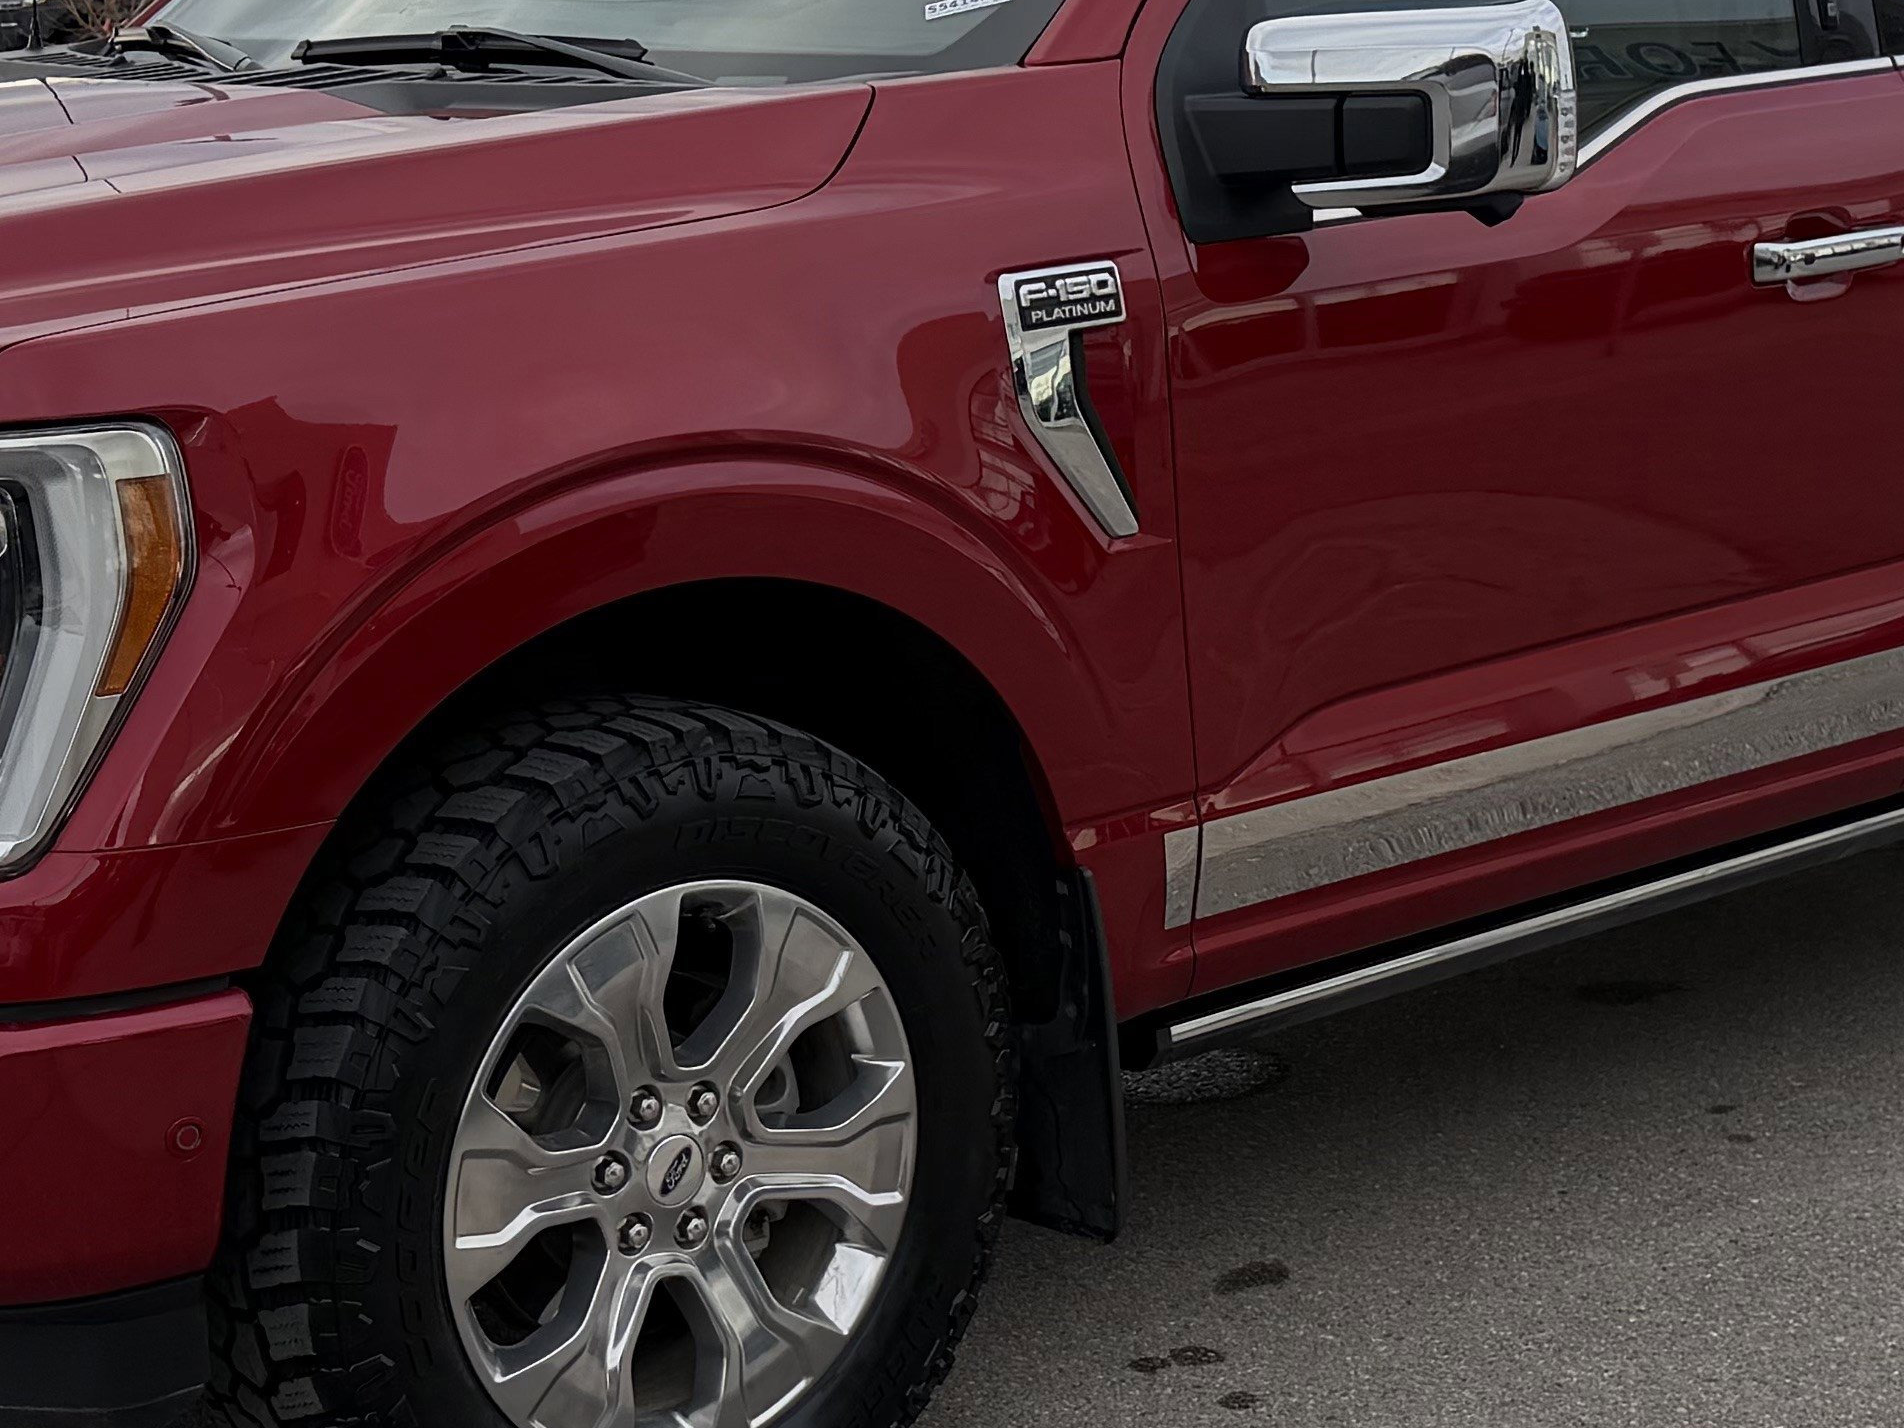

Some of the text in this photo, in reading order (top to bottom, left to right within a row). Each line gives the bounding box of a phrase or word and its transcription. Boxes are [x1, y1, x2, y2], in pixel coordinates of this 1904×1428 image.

[1019, 272, 1117, 307] F-150
[1031, 299, 1116, 323] PLATINUM
[664, 1152, 690, 1190] Ford
